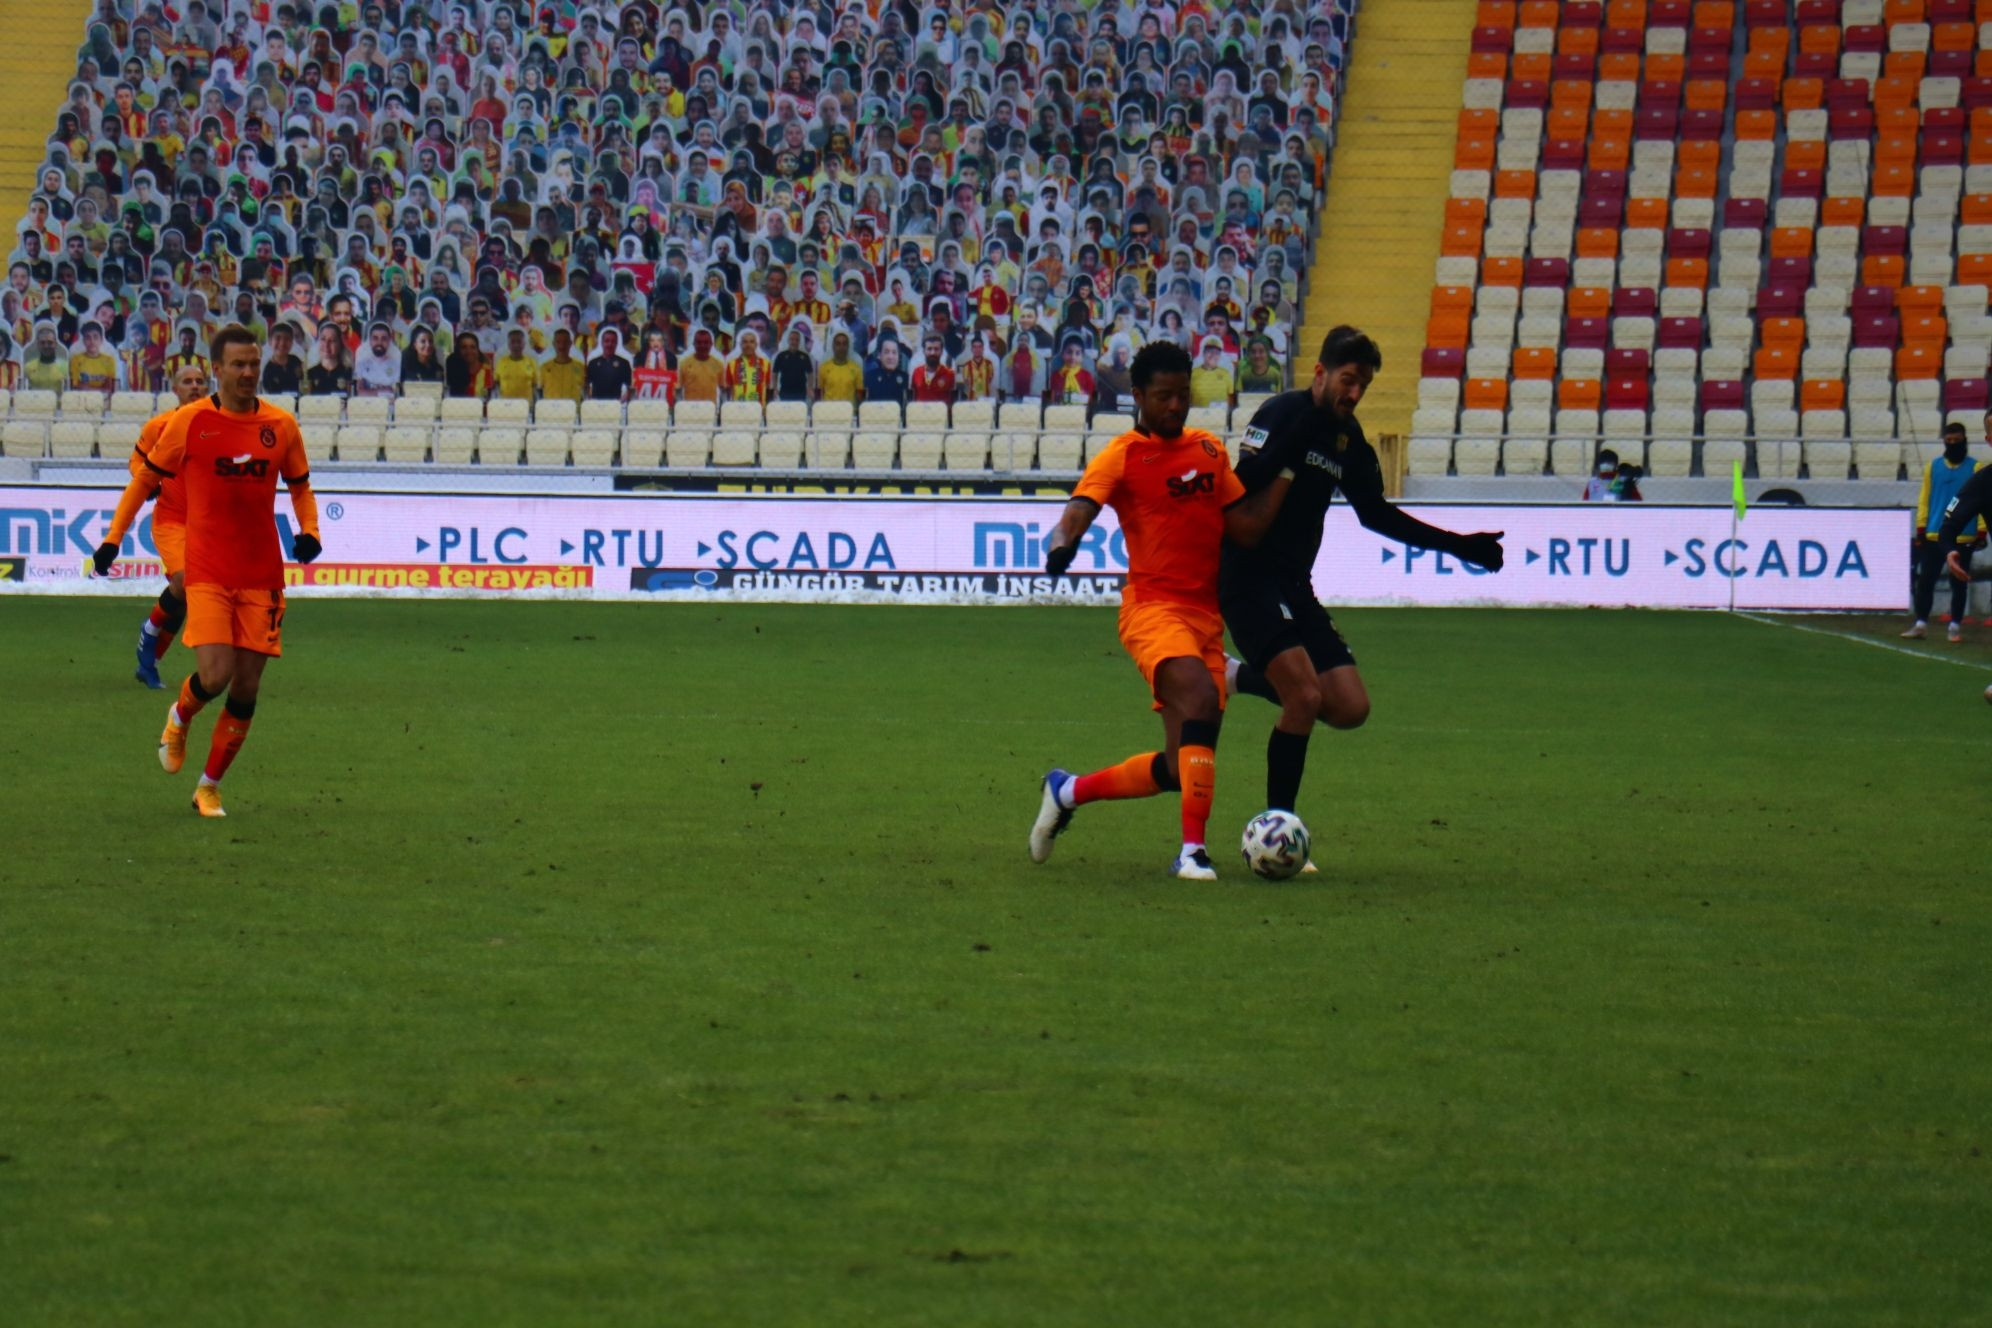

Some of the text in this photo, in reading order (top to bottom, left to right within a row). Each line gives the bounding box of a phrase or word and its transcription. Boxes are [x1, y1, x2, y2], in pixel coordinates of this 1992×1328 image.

[440, 526, 896, 570] PLC RTU SCADA
[1549, 538, 1630, 577] RTU
[1683, 538, 1869, 578] SCADA
[877, 576, 984, 595] TARIM
